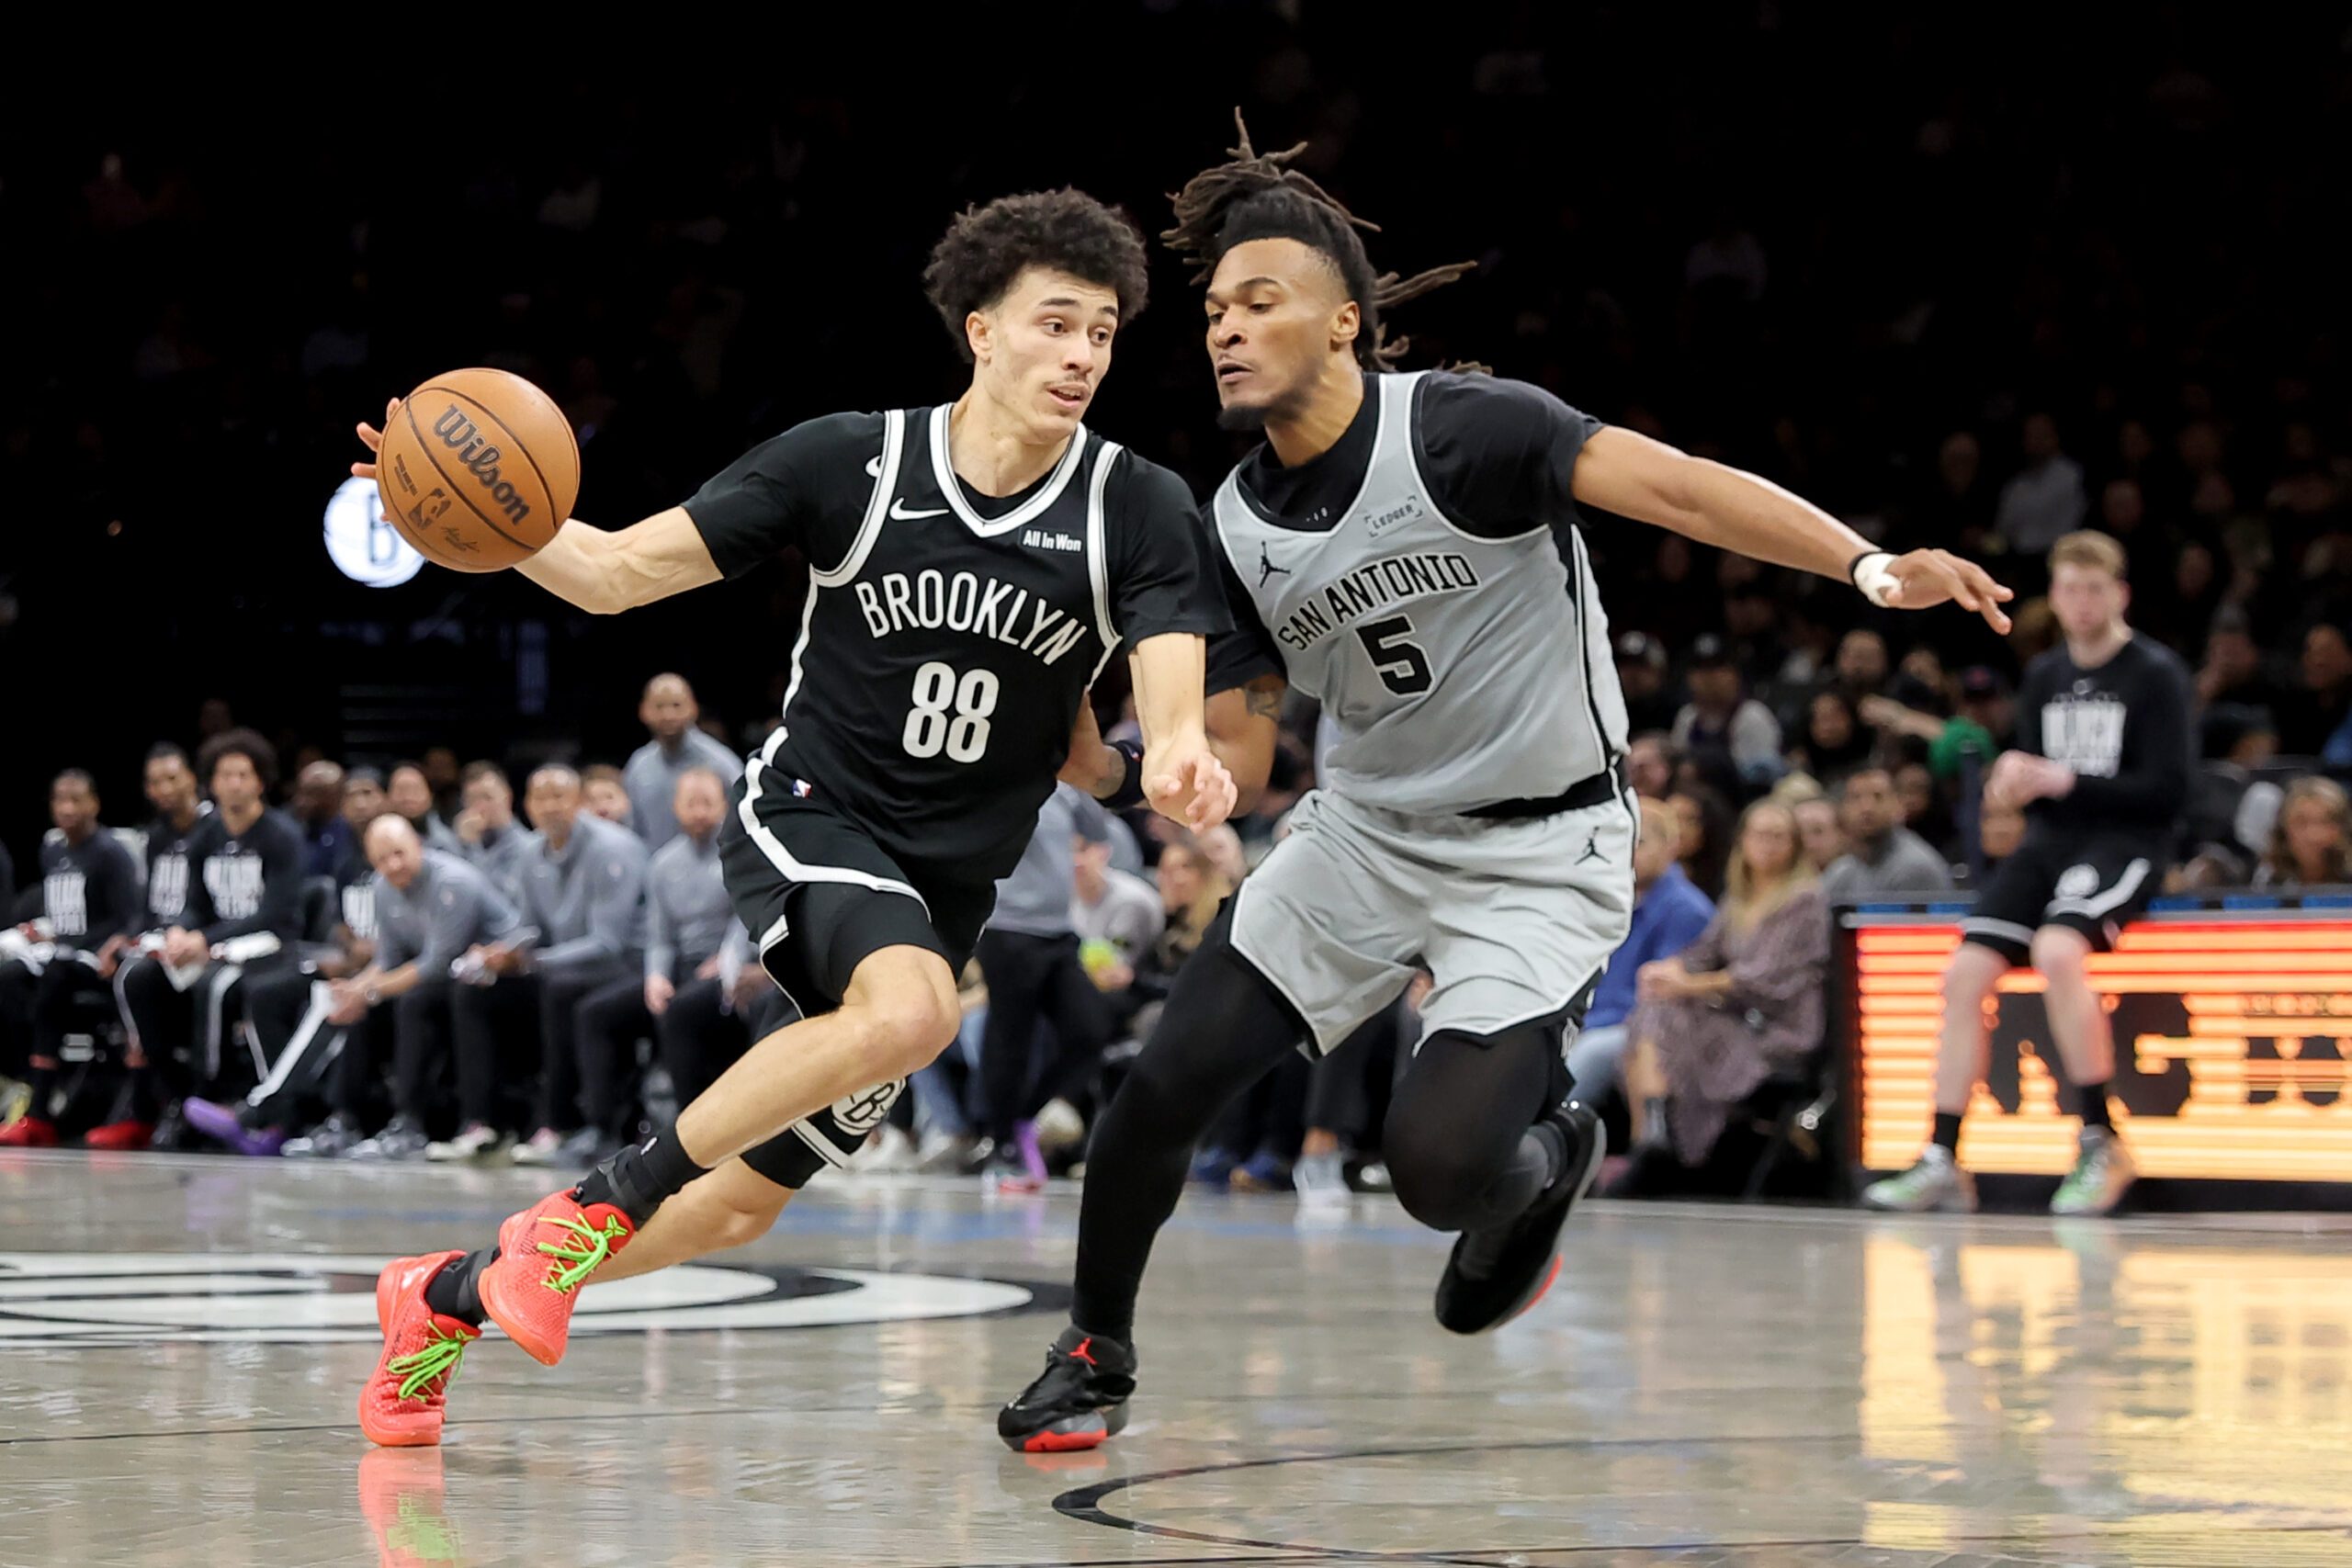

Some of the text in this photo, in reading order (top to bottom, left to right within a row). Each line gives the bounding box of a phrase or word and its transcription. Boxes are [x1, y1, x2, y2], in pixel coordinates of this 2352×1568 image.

[433, 403, 530, 525] Wilson
[1023, 529, 1082, 551] All In Won
[1371, 503, 1415, 530] LEDGER
[854, 569, 1088, 666] BROOKLYN
[1277, 554, 1479, 651] SAN ANTONIO
[1354, 615, 1432, 696] 5
[902, 661, 1000, 763] 88
